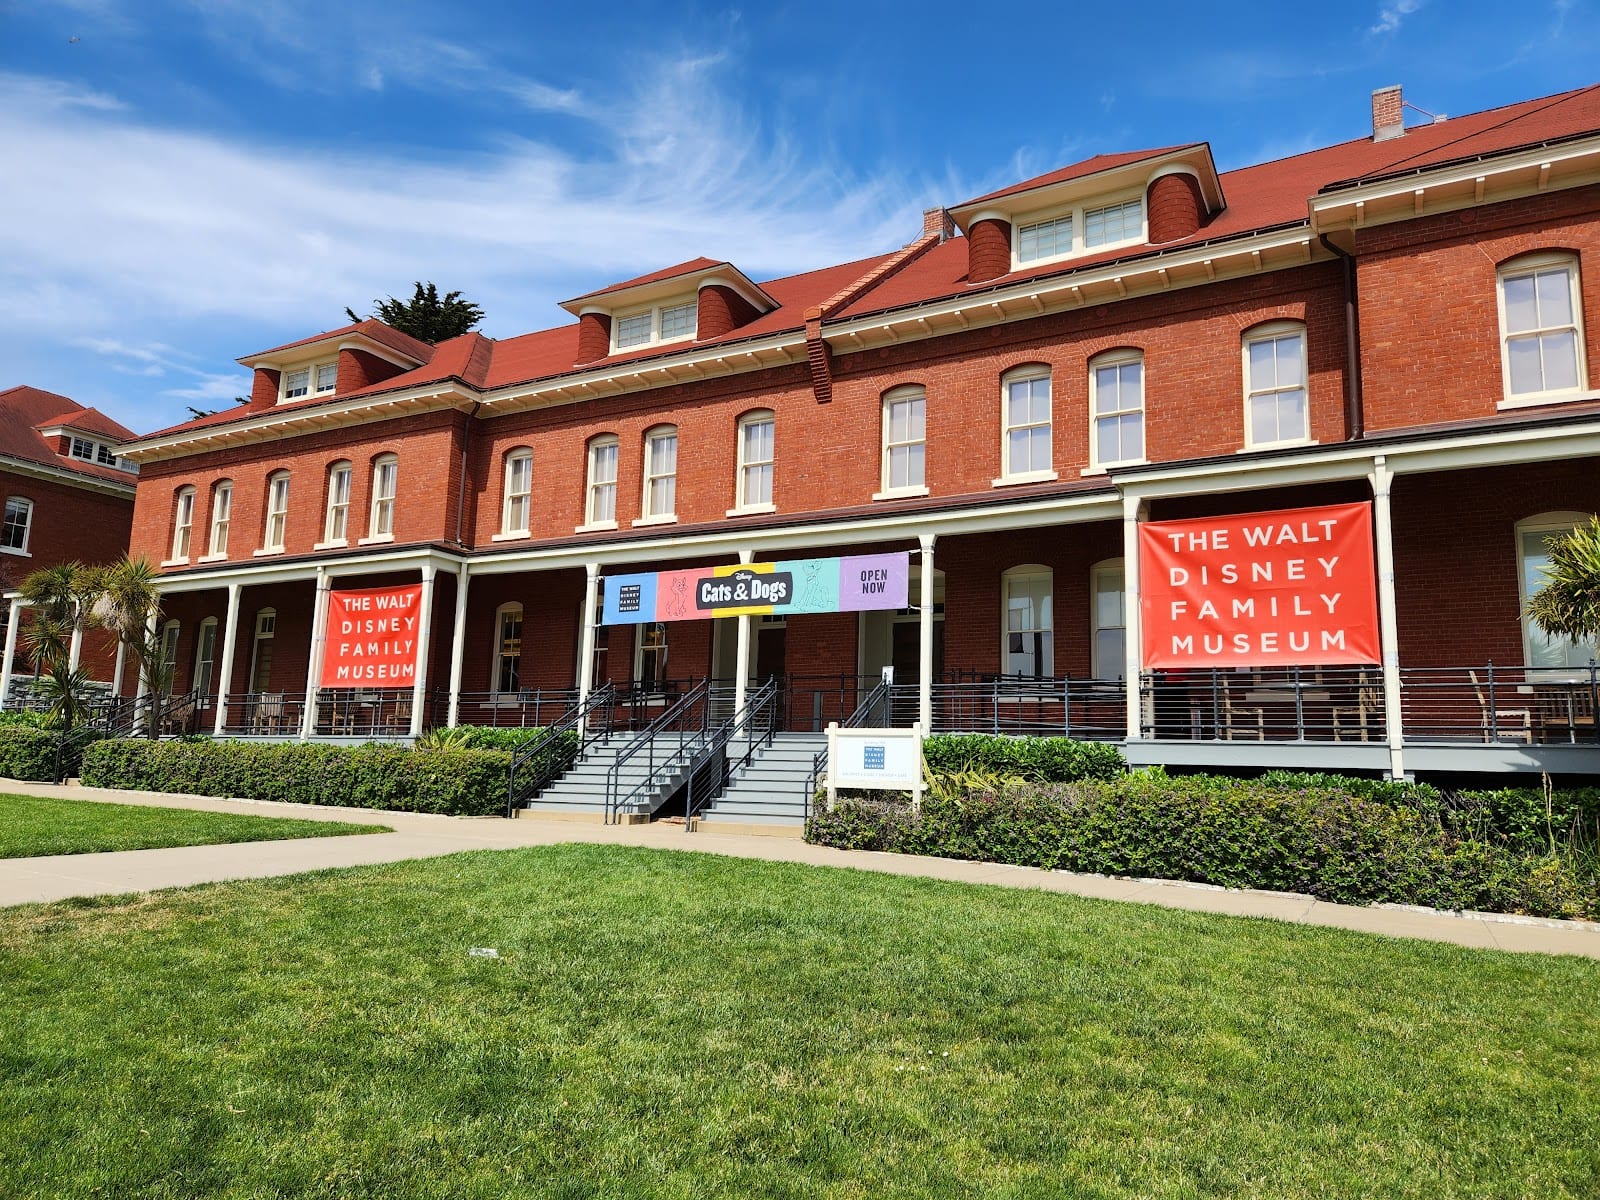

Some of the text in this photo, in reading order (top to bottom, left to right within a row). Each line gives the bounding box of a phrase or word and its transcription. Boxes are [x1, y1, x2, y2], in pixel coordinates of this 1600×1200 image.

[1168, 520, 1338, 553] THE WALT
[860, 569, 888, 582] OPEN
[1169, 556, 1339, 587] DISNEY
[701, 579, 787, 603] Cats & Dogs
[862, 581, 886, 594] NOW
[343, 594, 414, 612] THE WALT
[1171, 593, 1341, 621] FAMILY
[341, 617, 414, 634] DISNEY
[340, 640, 412, 657] FAMILY
[1172, 630, 1346, 655] MUSEUM
[337, 664, 414, 679] MUSEUM
